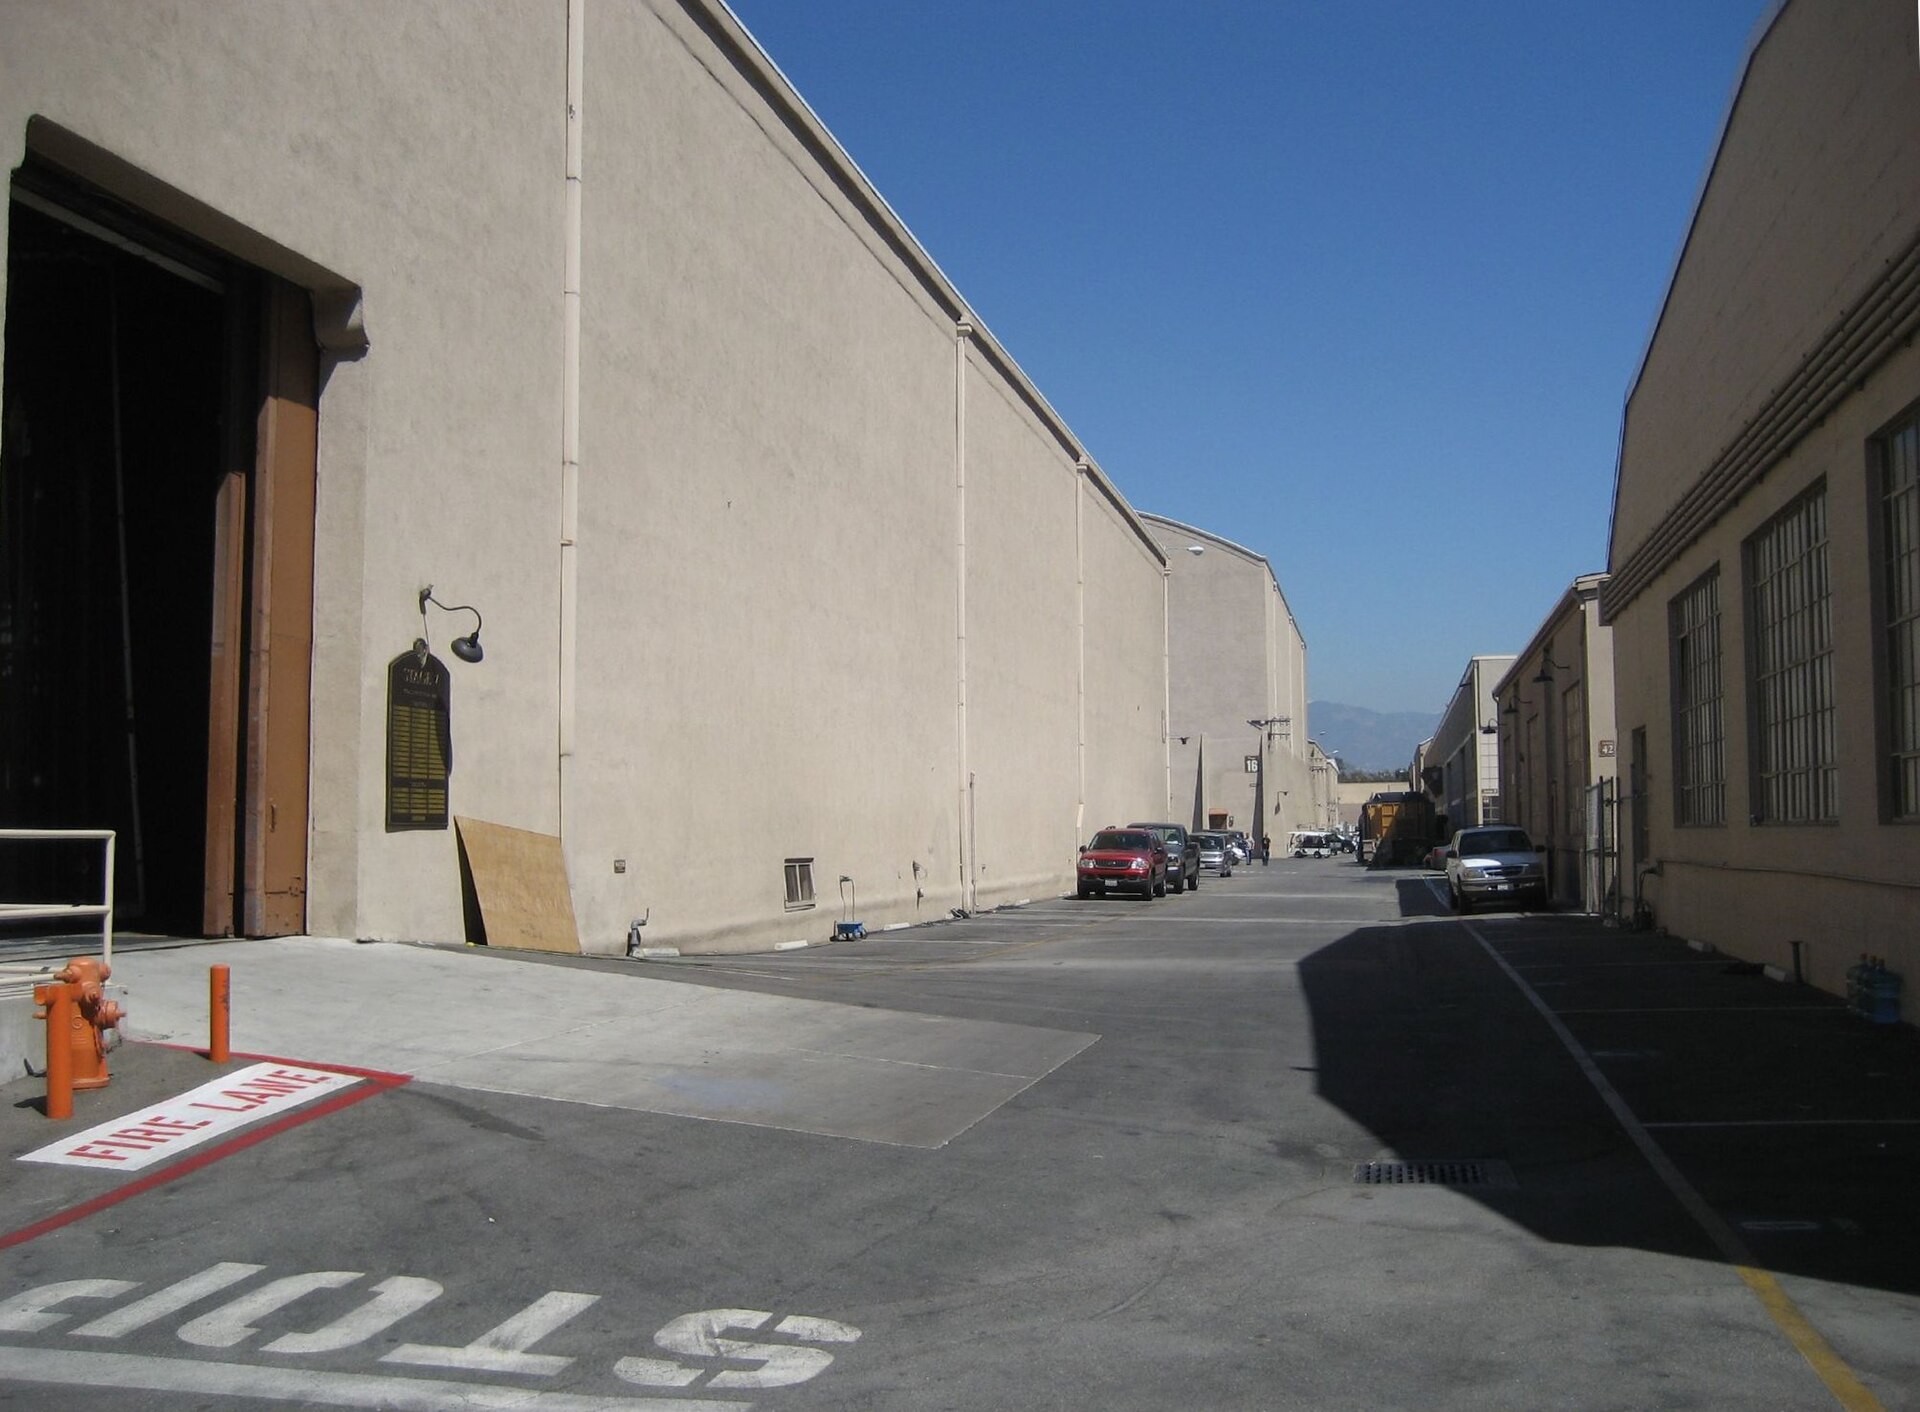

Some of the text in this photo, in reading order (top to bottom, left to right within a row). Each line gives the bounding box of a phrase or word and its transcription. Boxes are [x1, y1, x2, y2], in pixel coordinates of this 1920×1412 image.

[1246, 759, 1258, 772] 16
[65, 1069, 332, 1161] FIRE LANE
